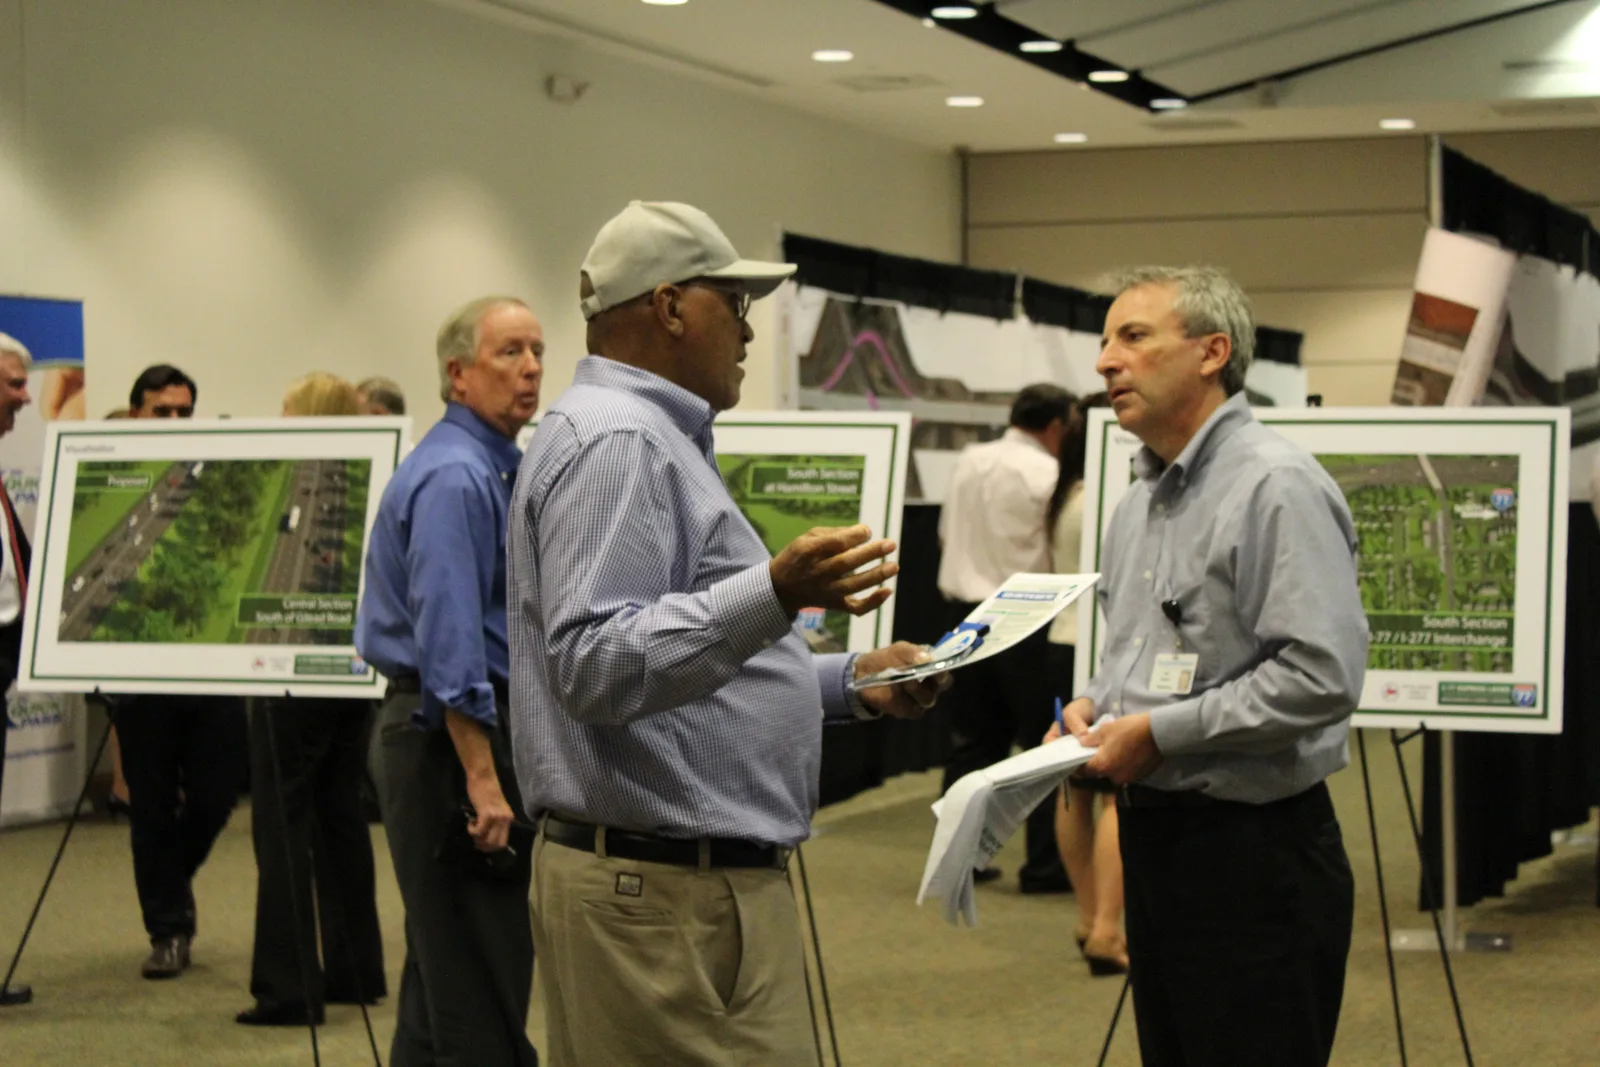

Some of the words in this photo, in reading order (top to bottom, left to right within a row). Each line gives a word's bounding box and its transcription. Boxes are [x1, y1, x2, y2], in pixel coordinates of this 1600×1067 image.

[787, 467, 818, 479] South
[820, 467, 859, 479] Section
[827, 482, 857, 494] Street
[319, 597, 353, 611] Section
[1422, 615, 1459, 628] South
[1461, 615, 1507, 629] Section
[1433, 632, 1507, 647] Interchange
